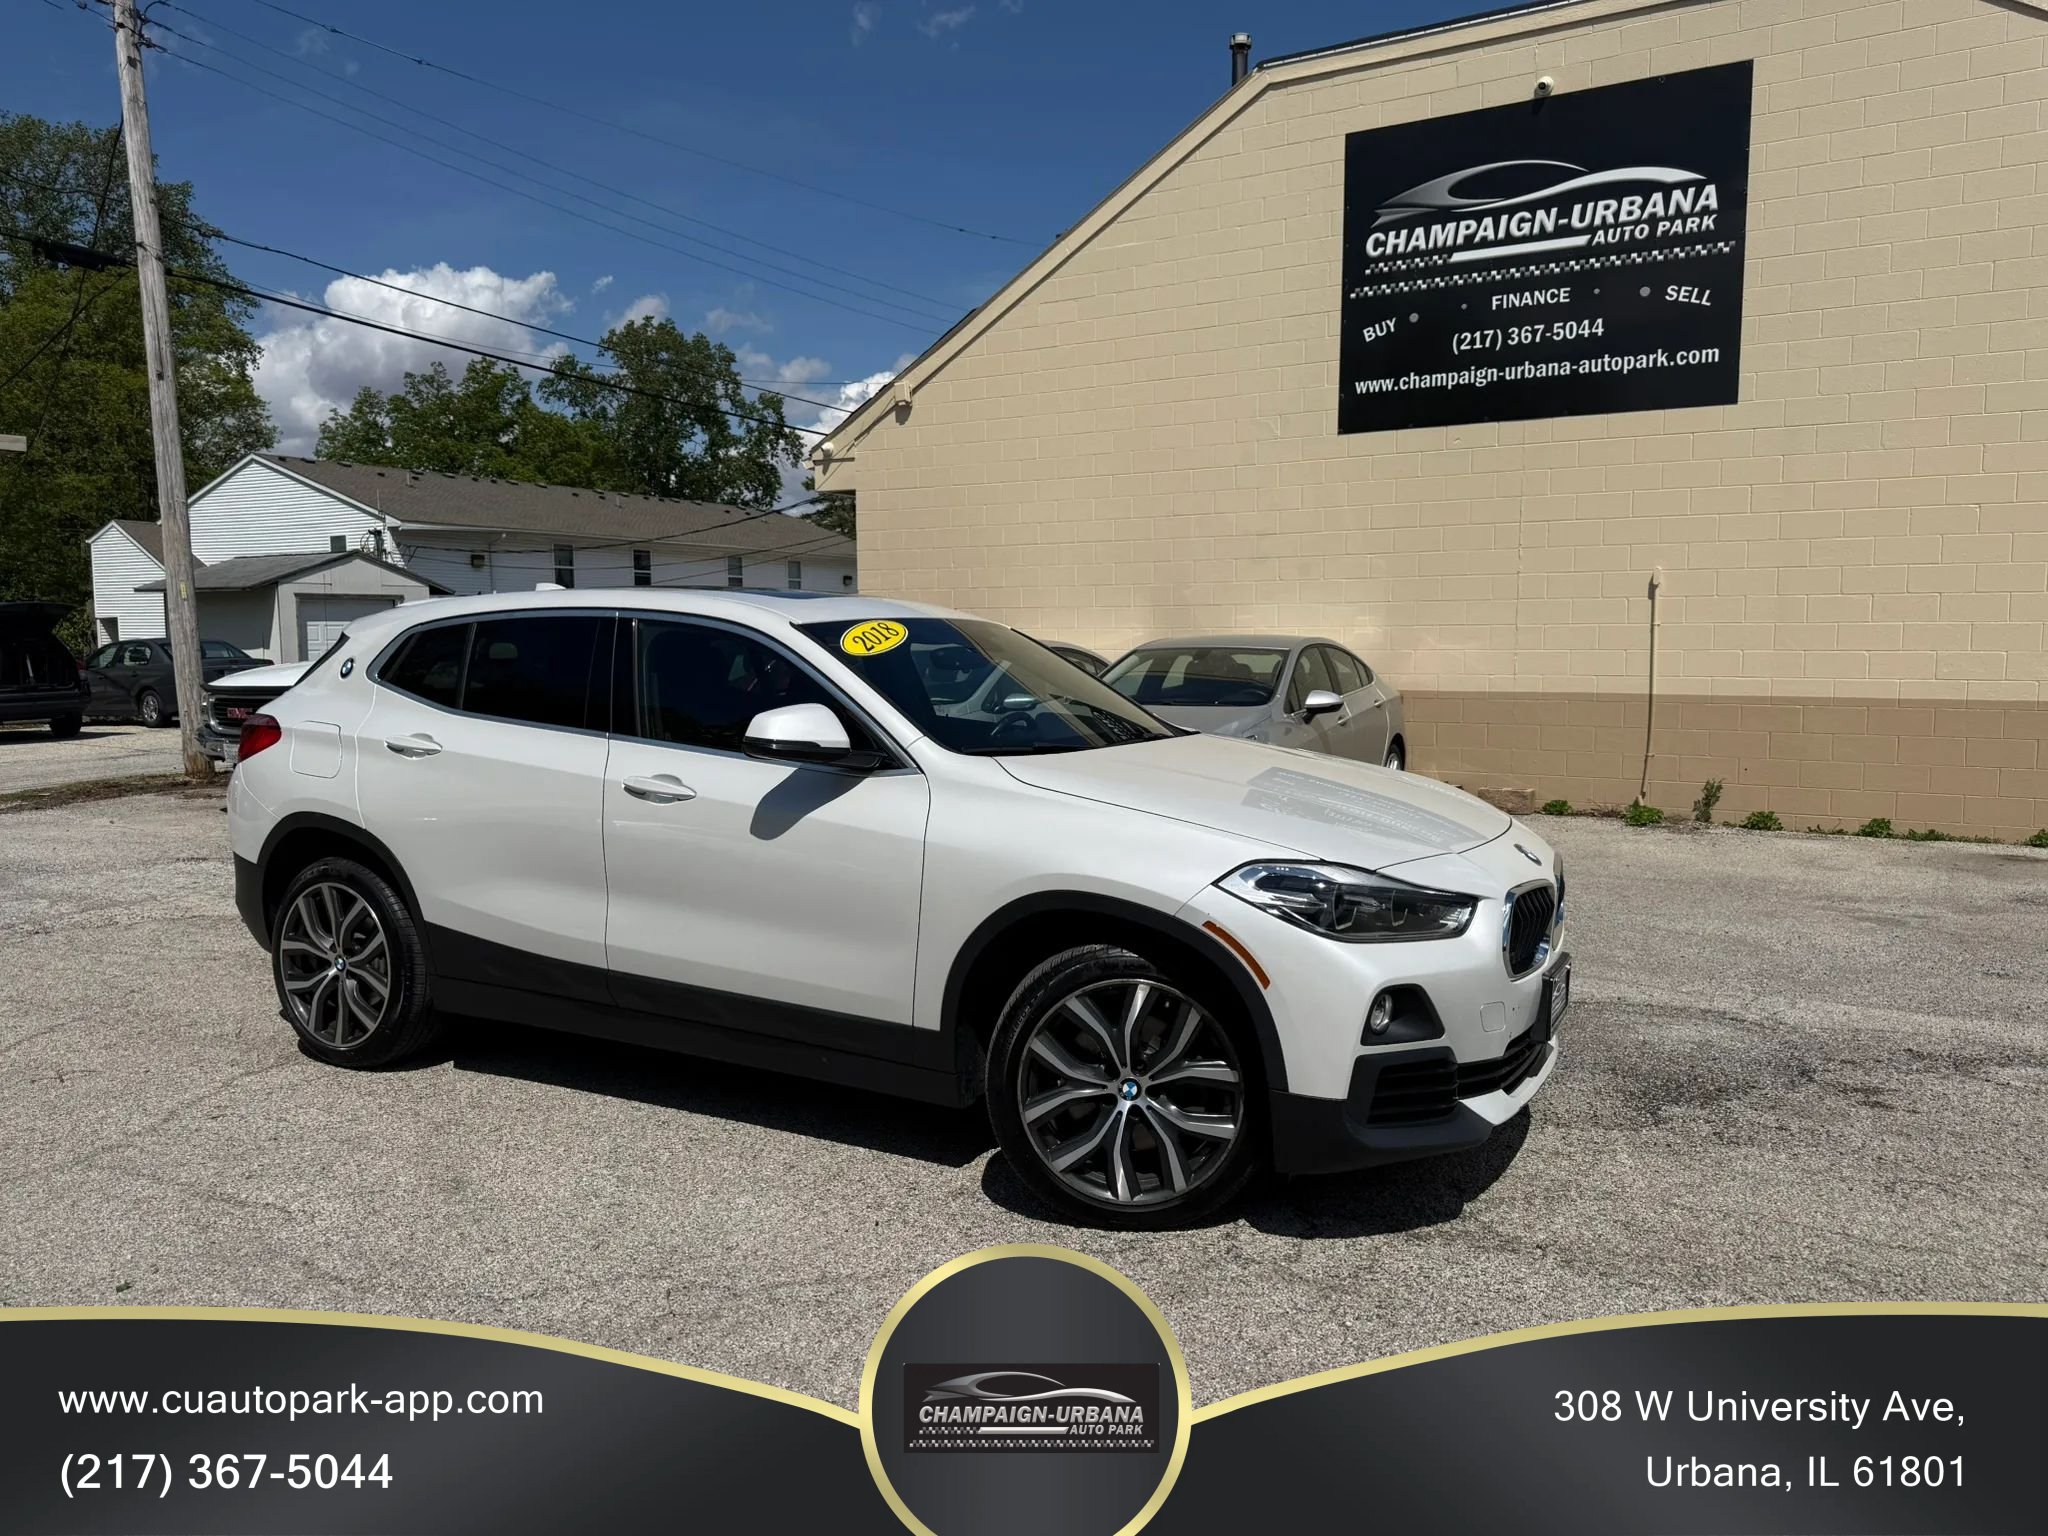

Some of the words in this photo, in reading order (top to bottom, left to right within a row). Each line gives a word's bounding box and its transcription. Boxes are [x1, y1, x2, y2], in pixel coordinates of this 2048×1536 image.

[1365, 184, 1719, 258] CHAMPAIGN-URBANA
[1591, 223, 1650, 247] AUTO
[1656, 214, 1718, 238] PARK
[1362, 317, 1398, 344] BUY
[1490, 287, 1571, 311] FINANCE
[1664, 284, 1713, 307] SELL
[1452, 329, 1502, 356] (217)
[1507, 318, 1605, 346] 367-5044
[1354, 346, 1721, 395] www.champaign-urbana-autopark.com
[852, 622, 900, 652] 2018
